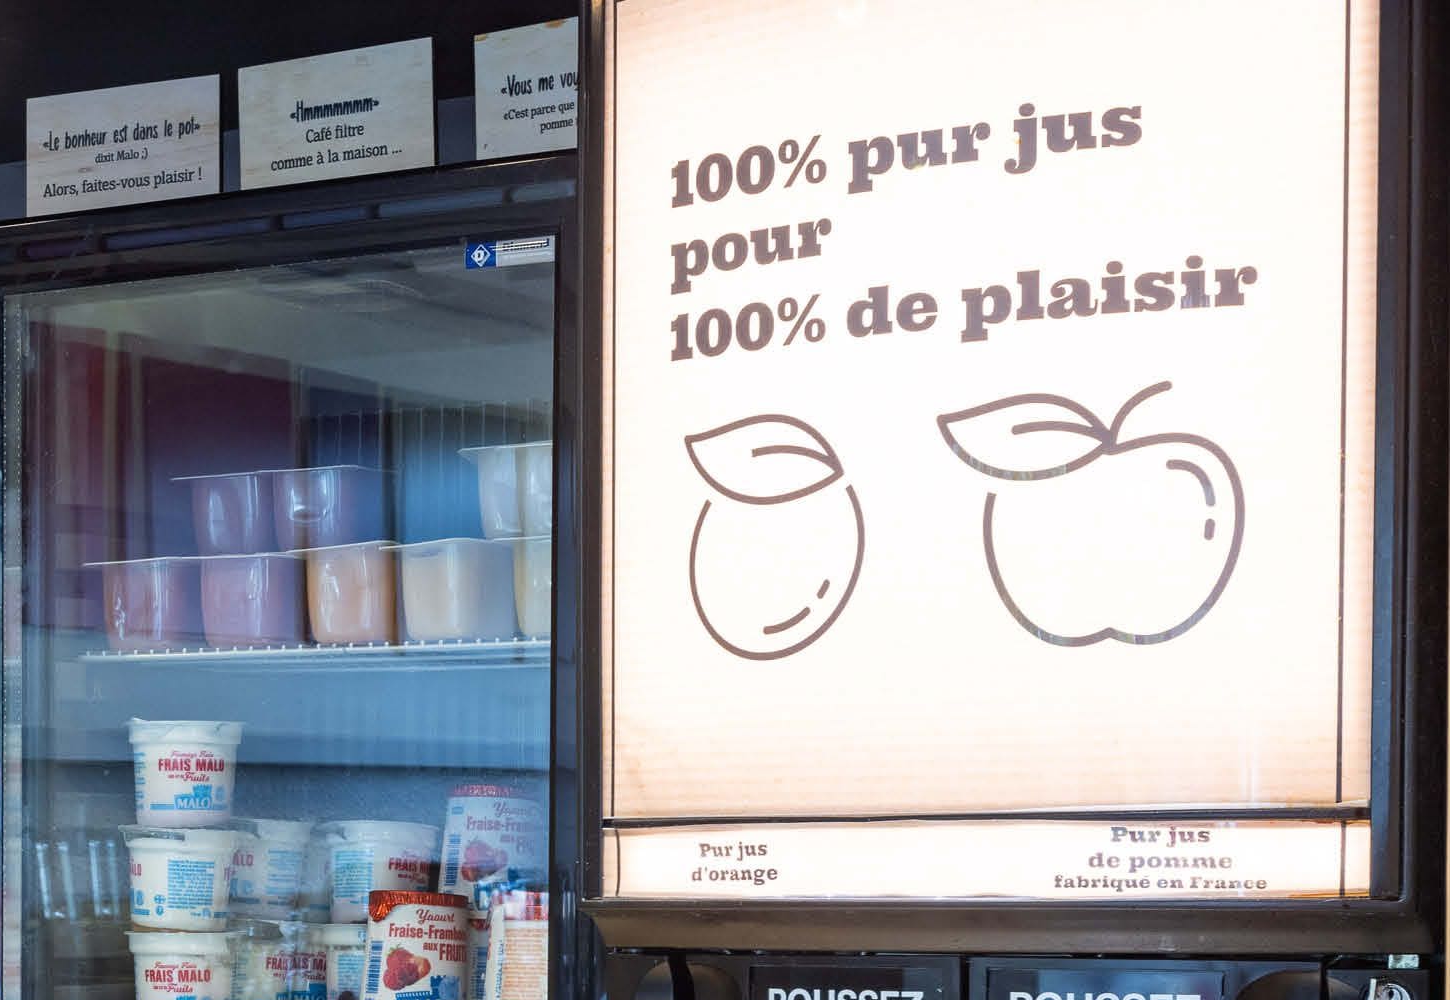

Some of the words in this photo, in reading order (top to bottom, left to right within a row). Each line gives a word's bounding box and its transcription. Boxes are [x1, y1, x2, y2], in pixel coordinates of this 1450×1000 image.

[538, 74, 555, 92] me
[530, 104, 557, 120] parce
[558, 101, 575, 114] que
[64, 129, 107, 149] bonheur
[113, 125, 128, 143] est
[133, 122, 158, 141] dans
[164, 119, 173, 137] le
[305, 126, 332, 144] Café
[335, 124, 365, 140] filtre
[540, 118, 574, 134] pomme
[95, 151, 115, 164] dixit
[116, 149, 140, 162] Malo
[270, 155, 313, 172] comme
[316, 151, 325, 165] à
[327, 148, 339, 163] la
[343, 144, 389, 161] maison
[671, 135, 827, 208] 100%
[847, 121, 991, 194] pur
[1004, 102, 1143, 174] jus
[43, 183, 79, 198] Alors,
[81, 173, 151, 194] faites-vous
[153, 169, 195, 189] plaisir
[670, 217, 832, 295] pour
[671, 294, 826, 361] 100%
[846, 285, 938, 338] de
[960, 255, 1258, 343] plaisir
[158, 759, 191, 772] FRAIS
[1111, 826, 1160, 843] Pur
[1166, 826, 1210, 847] jus
[699, 842, 733, 858] Pur
[737, 841, 767, 861] jus
[1088, 852, 1120, 869] de
[1128, 855, 1232, 873] pomme
[691, 866, 778, 886] d'orange
[1054, 875, 1150, 893] fabriqué
[1156, 878, 1184, 889] en
[416, 908, 455, 925] Yaourt
[423, 943, 438, 951] aux
[145, 969, 174, 983] FRAIS
[178, 969, 212, 983] MALO
